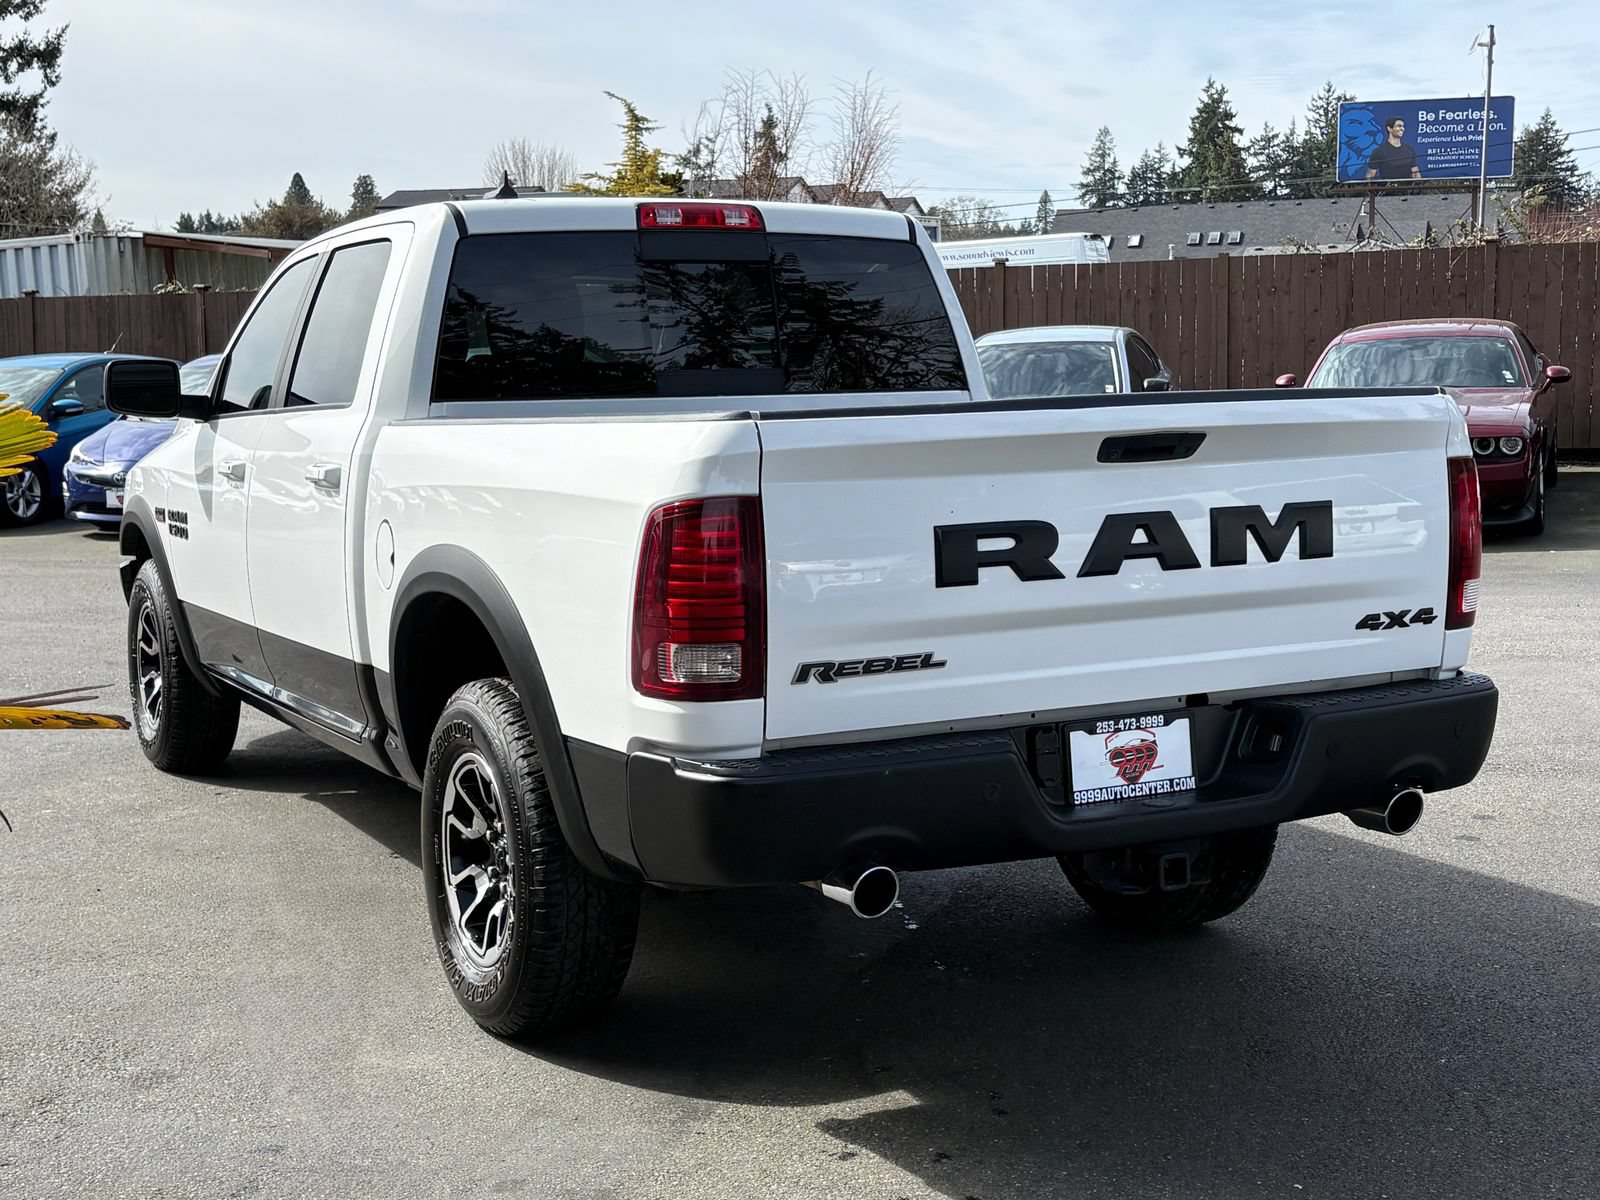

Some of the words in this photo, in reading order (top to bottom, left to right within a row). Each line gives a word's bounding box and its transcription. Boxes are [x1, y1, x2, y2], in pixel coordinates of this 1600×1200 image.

[1418, 110, 1436, 121] Be
[1417, 123, 1465, 134] Become
[1478, 121, 1507, 131] Lon.
[1427, 147, 1480, 155] BELLARMINE
[933, 500, 1334, 588] RAM
[791, 652, 948, 685] REBEL
[1096, 715, 1164, 733] 253-473-9999
[1074, 777, 1196, 803] 9999AUTOCENTER.COM
